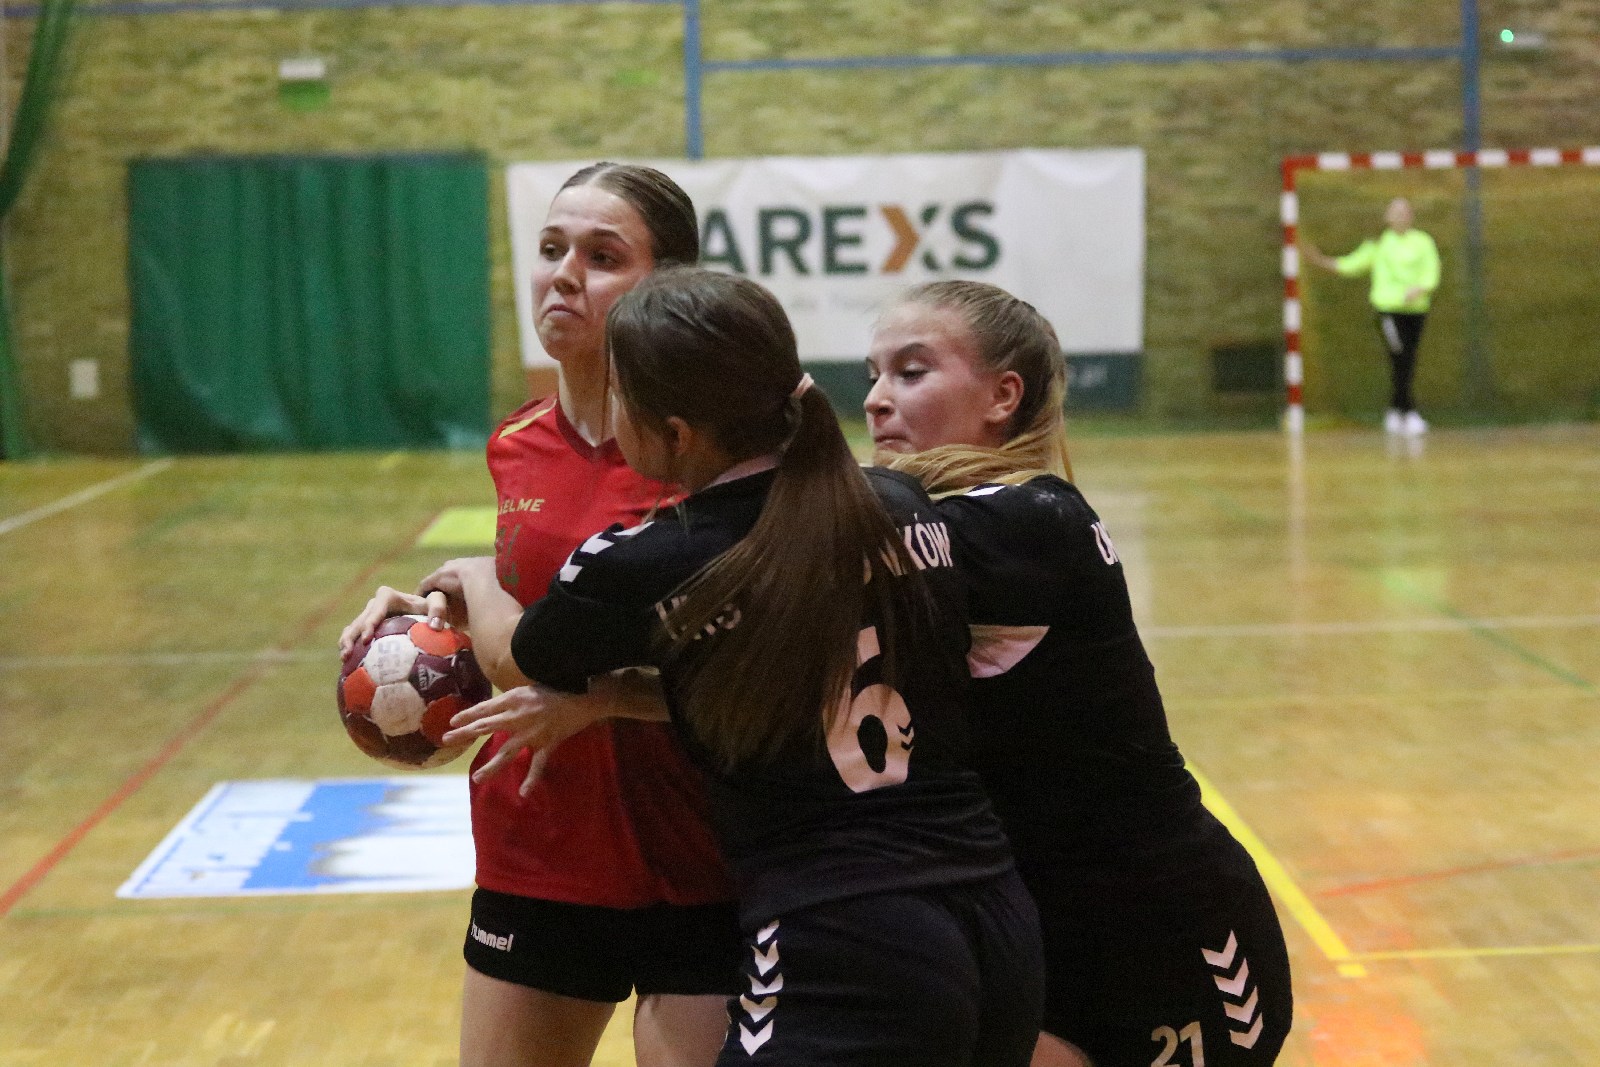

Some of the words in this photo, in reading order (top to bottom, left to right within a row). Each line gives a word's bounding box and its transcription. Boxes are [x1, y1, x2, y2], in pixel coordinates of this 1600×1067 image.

[824, 626, 915, 793] 6
[470, 918, 514, 952] hummel
[1150, 1020, 1205, 1067] 21
